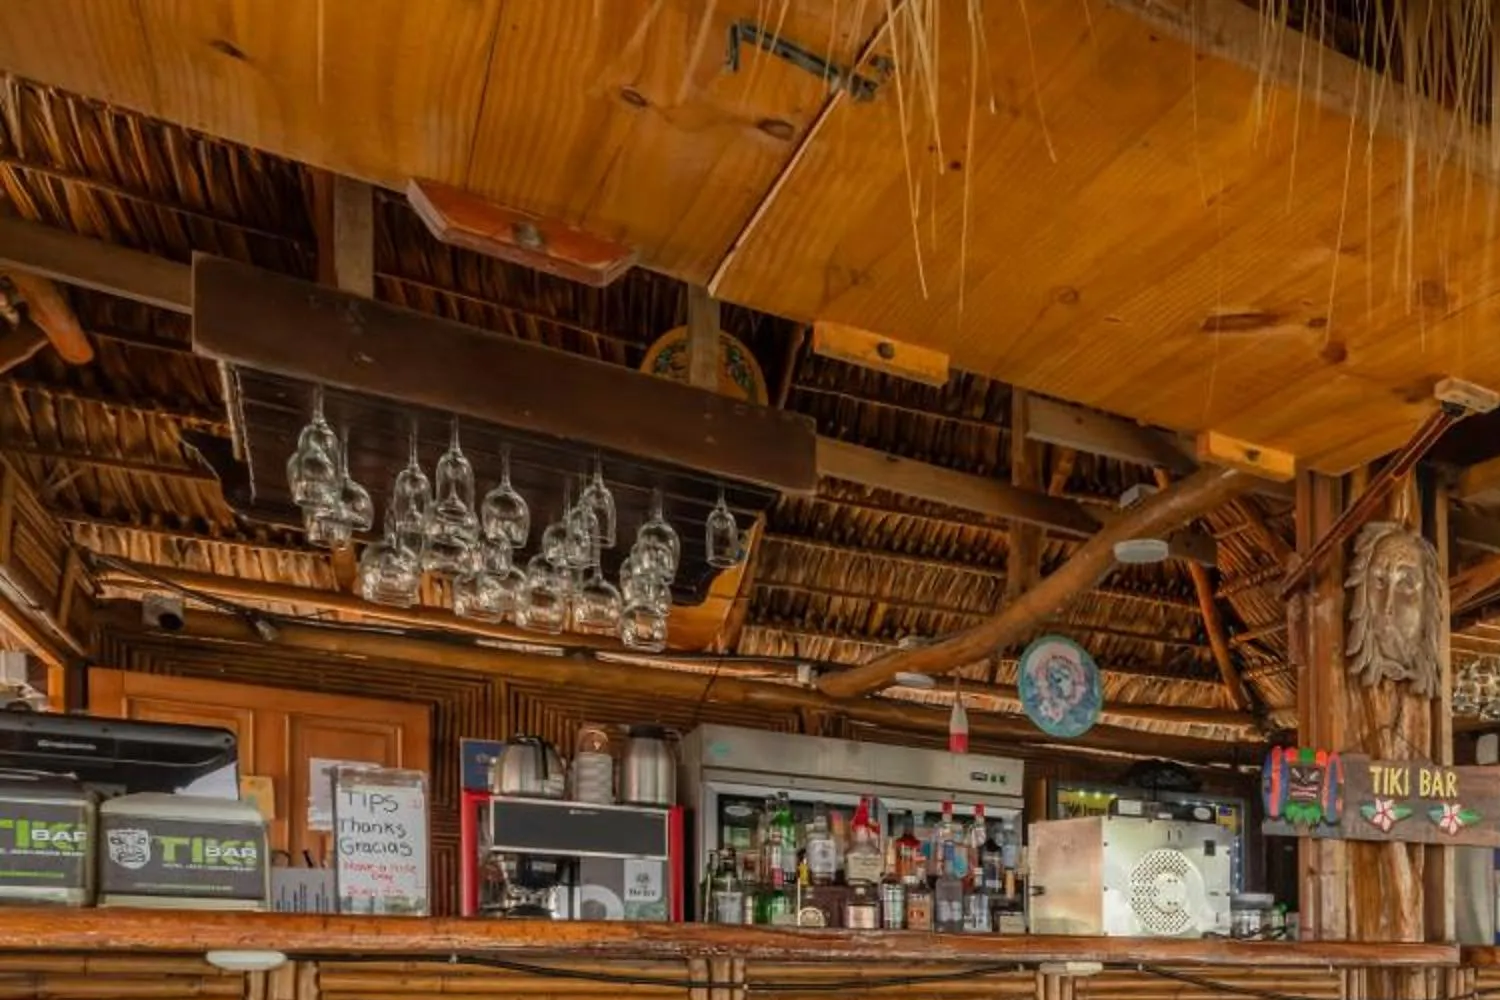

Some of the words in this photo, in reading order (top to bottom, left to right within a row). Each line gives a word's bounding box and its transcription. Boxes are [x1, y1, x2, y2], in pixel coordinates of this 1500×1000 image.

[1369, 765, 1410, 797] TIKI
[1419, 767, 1459, 798] BAR
[340, 789, 399, 813] TIPS
[340, 816, 407, 839] Thanks
[206, 846, 257, 859] BAR
[340, 837, 413, 857] Gracias
